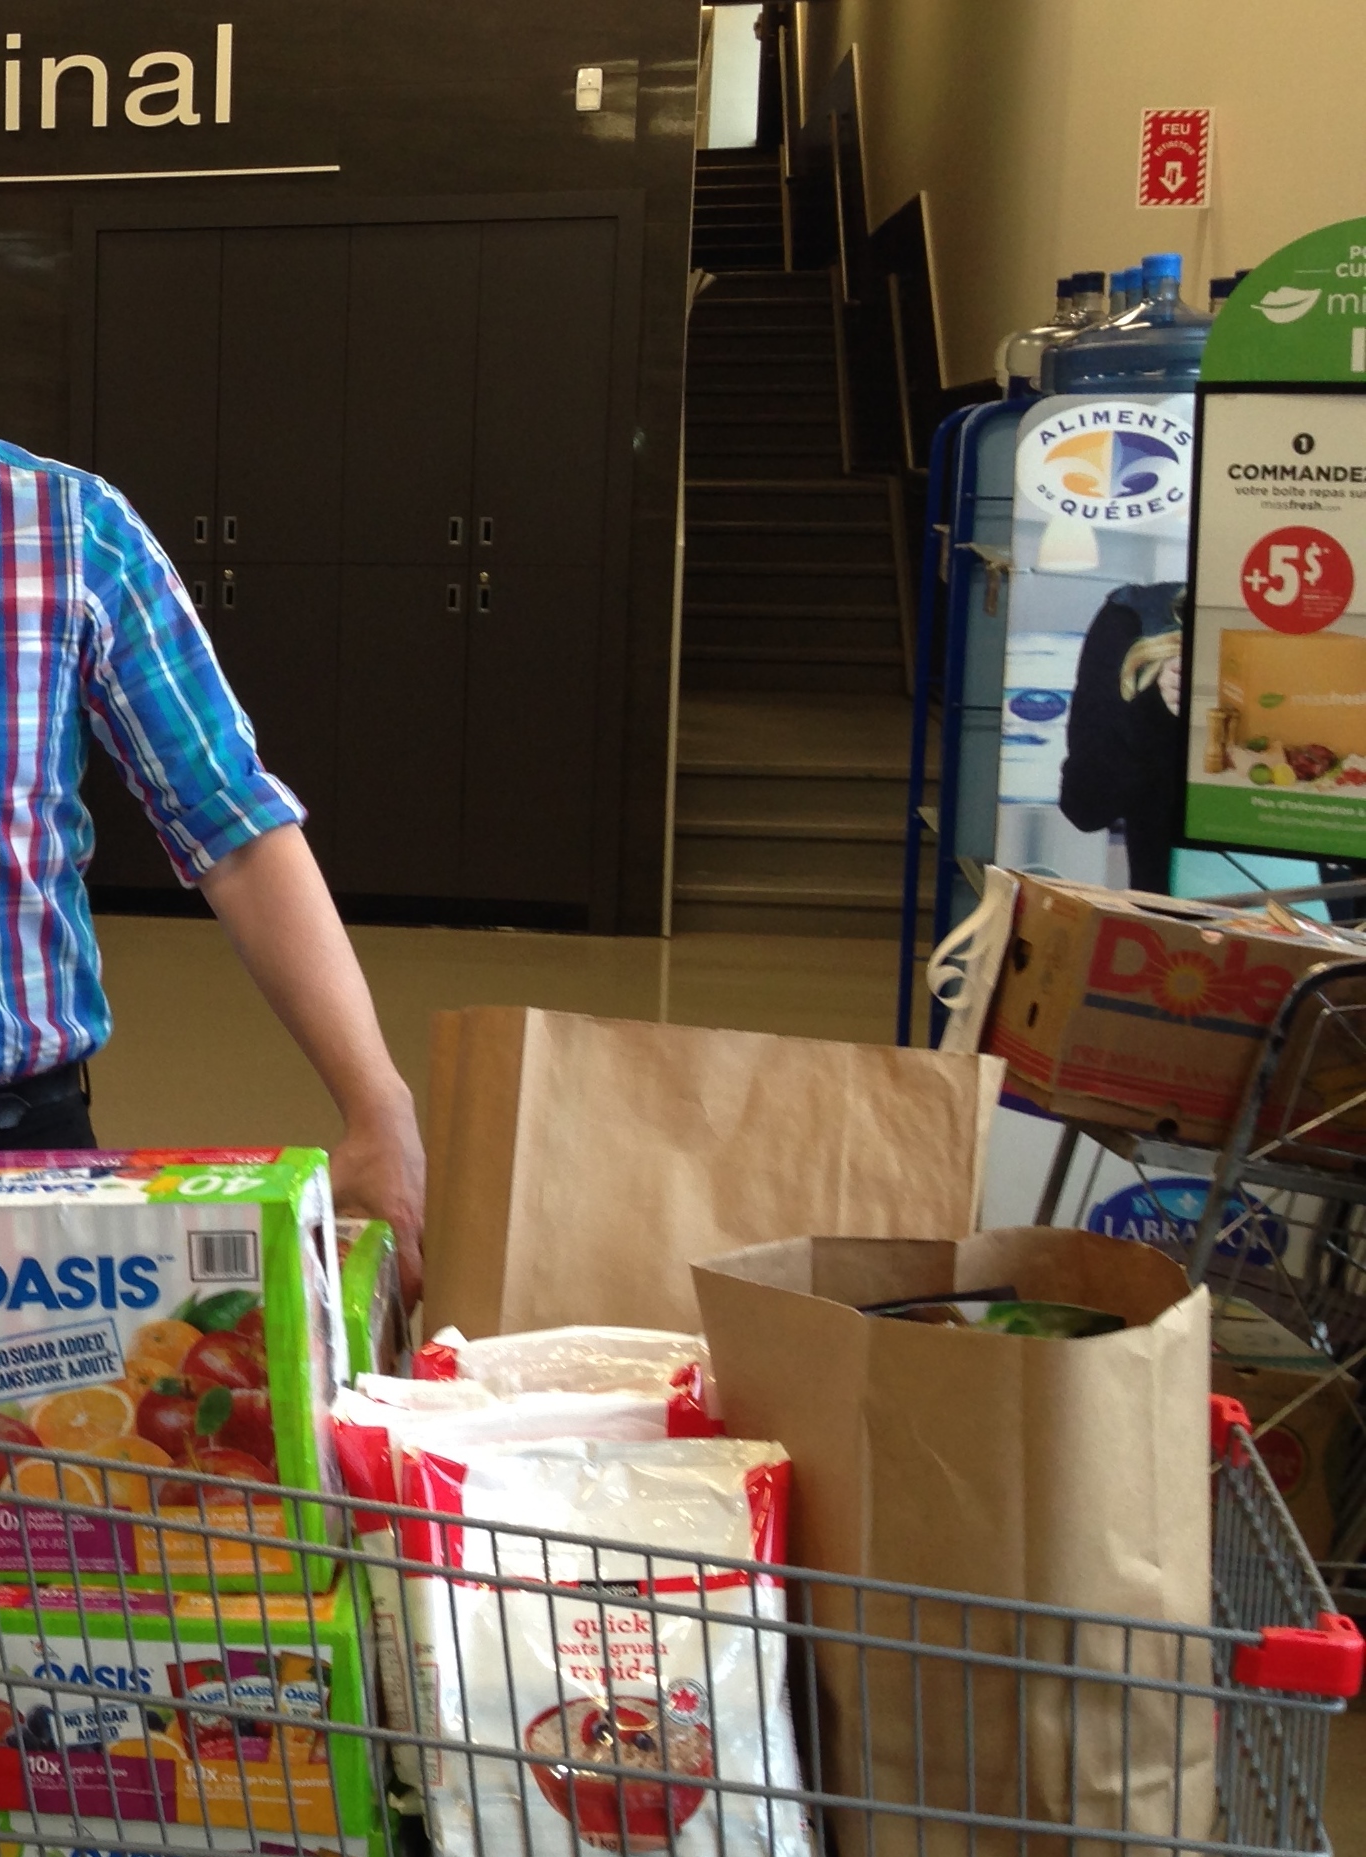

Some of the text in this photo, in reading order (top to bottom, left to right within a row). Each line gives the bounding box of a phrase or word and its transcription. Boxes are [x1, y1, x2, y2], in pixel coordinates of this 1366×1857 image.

[1161, 122, 1191, 136] FEU
[1039, 409, 1193, 447] ALIMENTS
[1036, 483, 1185, 520] DU QUÉBEC
[1234, 486, 1269, 497] votre
[1087, 915, 1298, 1026] Dole
[10, 1341, 59, 1366] SUGAR
[23, 1360, 66, 1388] SUCRE
[573, 1611, 651, 1639] quick
[33, 1660, 153, 1695] OASIS
[85, 1708, 129, 1725] SGAR
